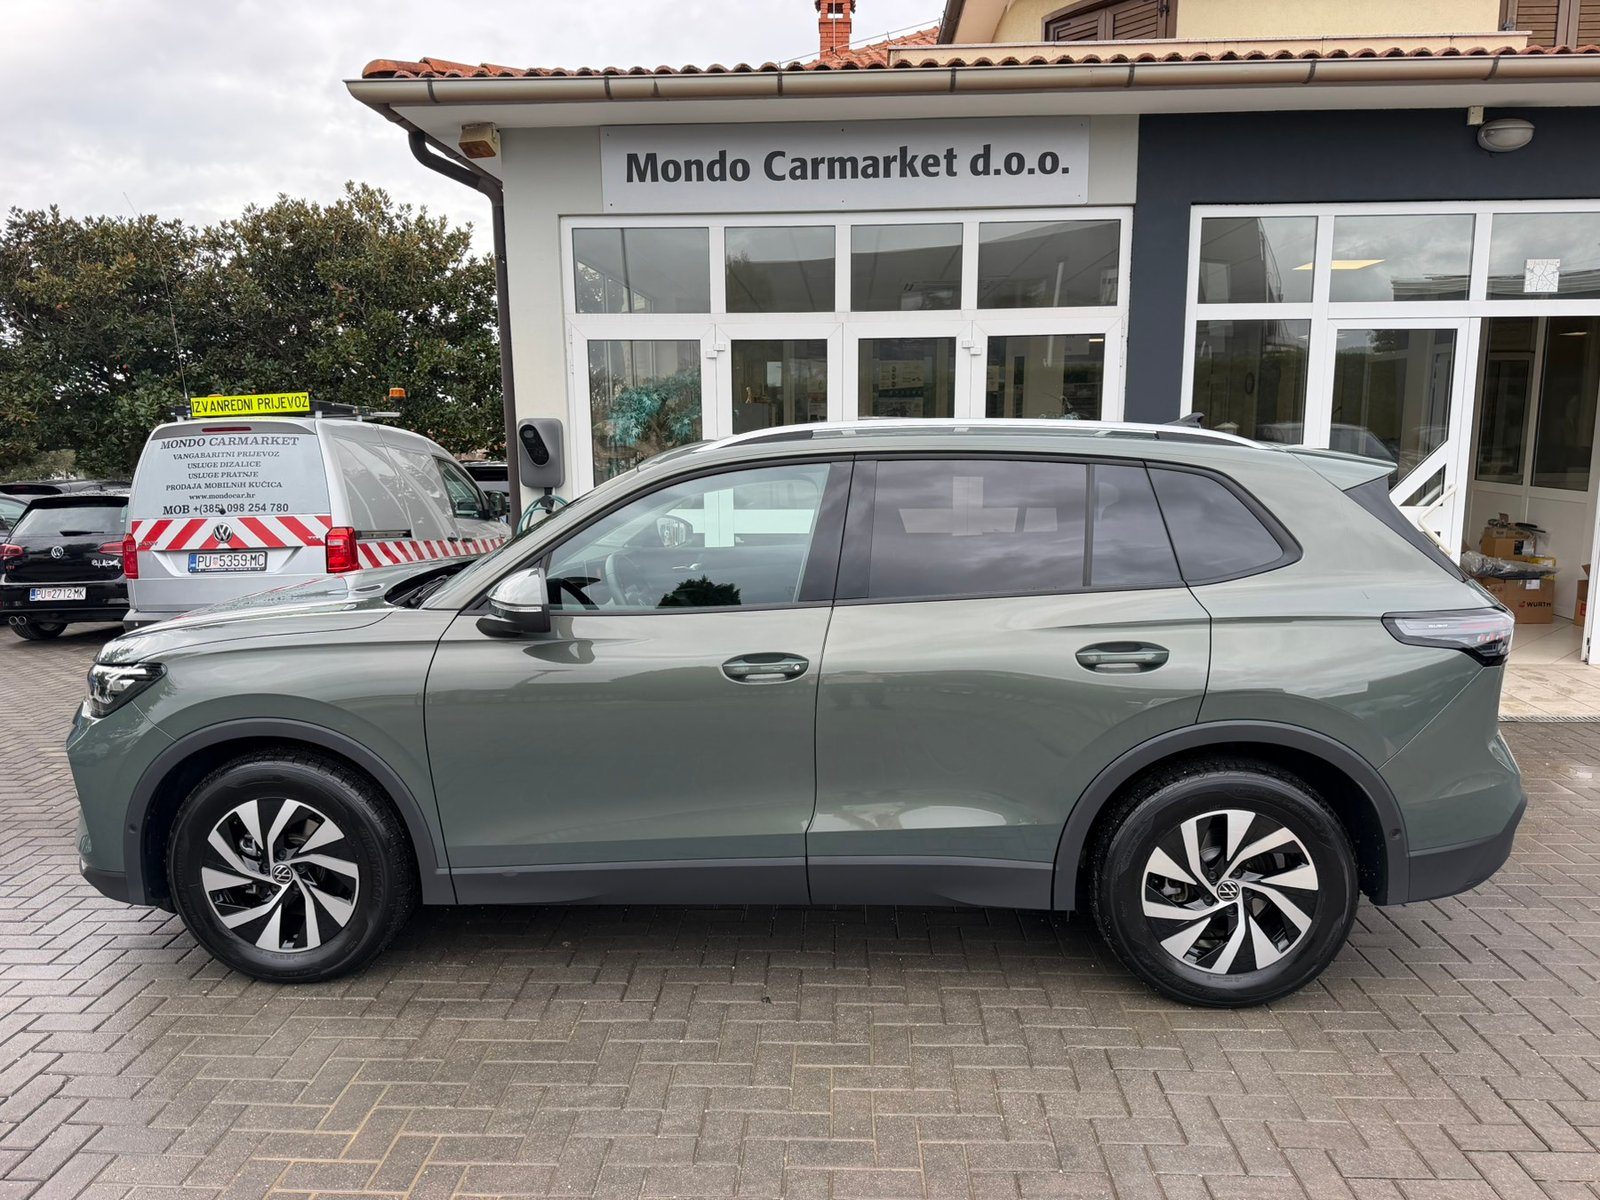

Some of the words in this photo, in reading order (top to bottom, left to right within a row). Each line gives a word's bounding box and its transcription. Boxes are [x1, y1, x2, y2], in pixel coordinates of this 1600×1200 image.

[625, 149, 751, 184] Mondo
[763, 145, 958, 182] Carmarket
[969, 143, 1070, 178] d.o.o.
[191, 398, 253, 413] IZVANREDNI
[257, 395, 309, 410] PRIJEVOZ
[160, 437, 206, 450] MONDO
[209, 436, 300, 447] CARMARKET
[172, 451, 236, 460] VANGABARITNI
[236, 450, 280, 458] PRIJEVOZ
[187, 462, 219, 470] USLUGE
[219, 460, 262, 468] DIZALICE
[188, 472, 220, 480] USLUGE
[165, 482, 203, 491] PRODAJA
[188, 492, 256, 500] www.mondocar.hr
[162, 504, 190, 515] MOB
[226, 503, 245, 513] 098
[248, 503, 267, 513] 254
[270, 503, 289, 512] 780
[197, 555, 212, 568] PU
[36, 589, 47, 599] PU
